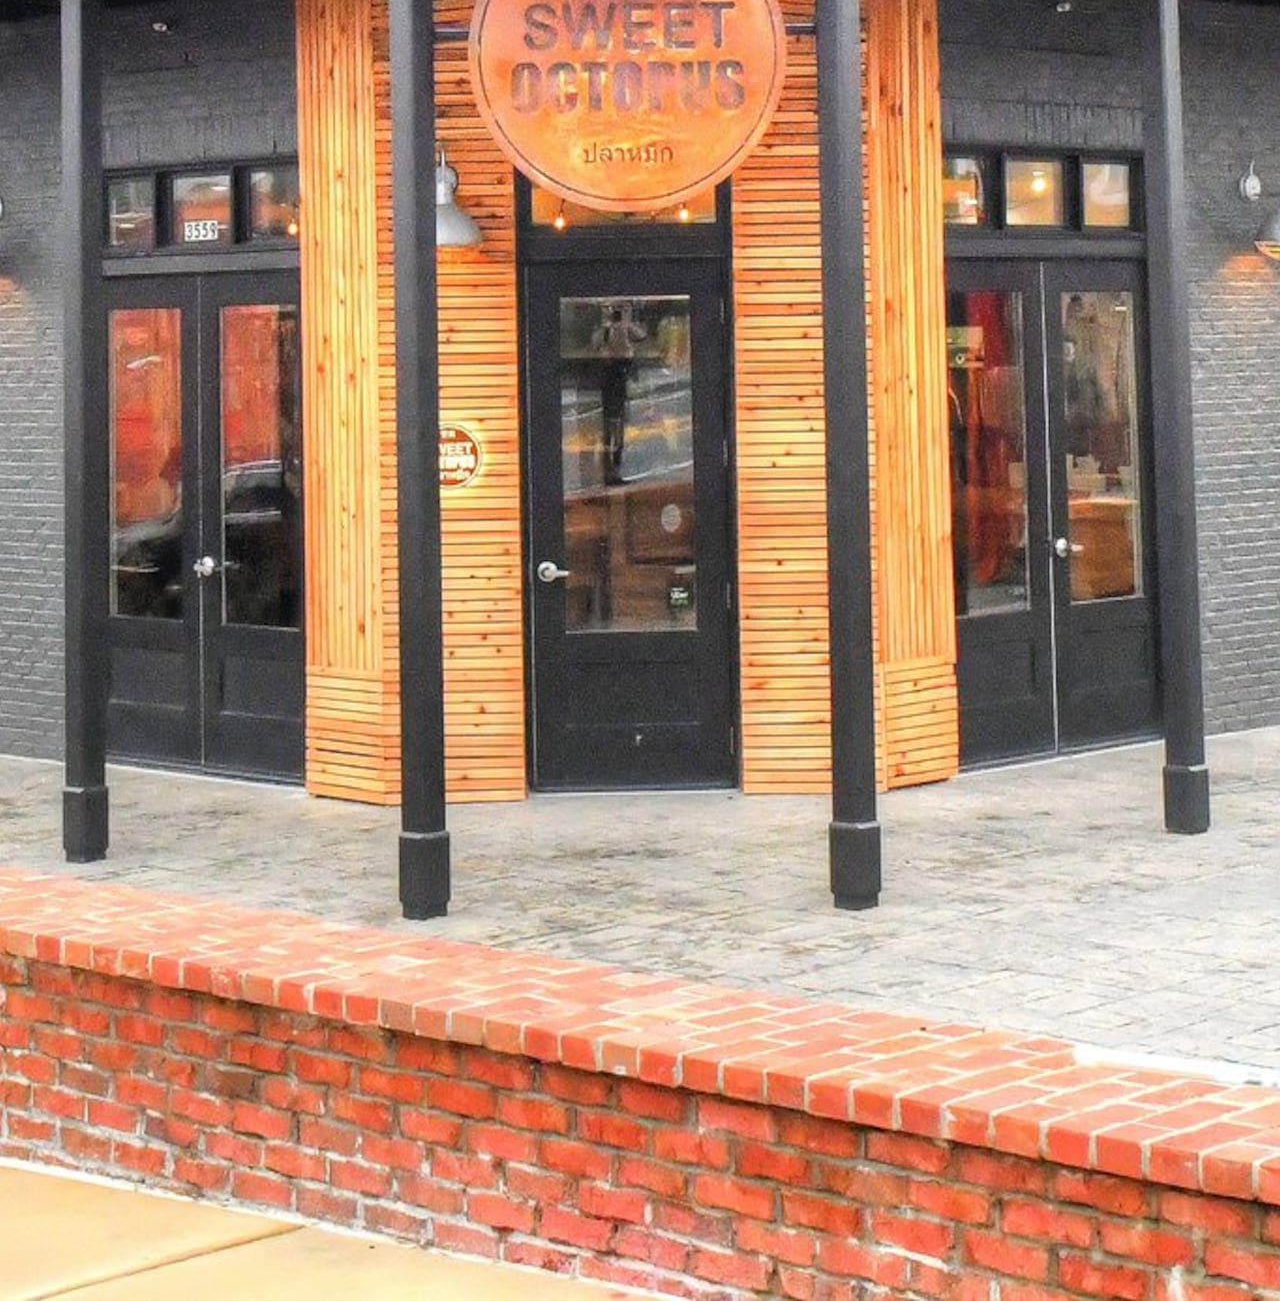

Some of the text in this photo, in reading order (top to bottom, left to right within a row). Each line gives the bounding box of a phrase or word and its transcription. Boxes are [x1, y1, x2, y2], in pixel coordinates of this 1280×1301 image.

[522, 0, 737, 53] SWEET
[510, 59, 746, 115] OCTOPUS
[186, 222, 218, 238] 3559
